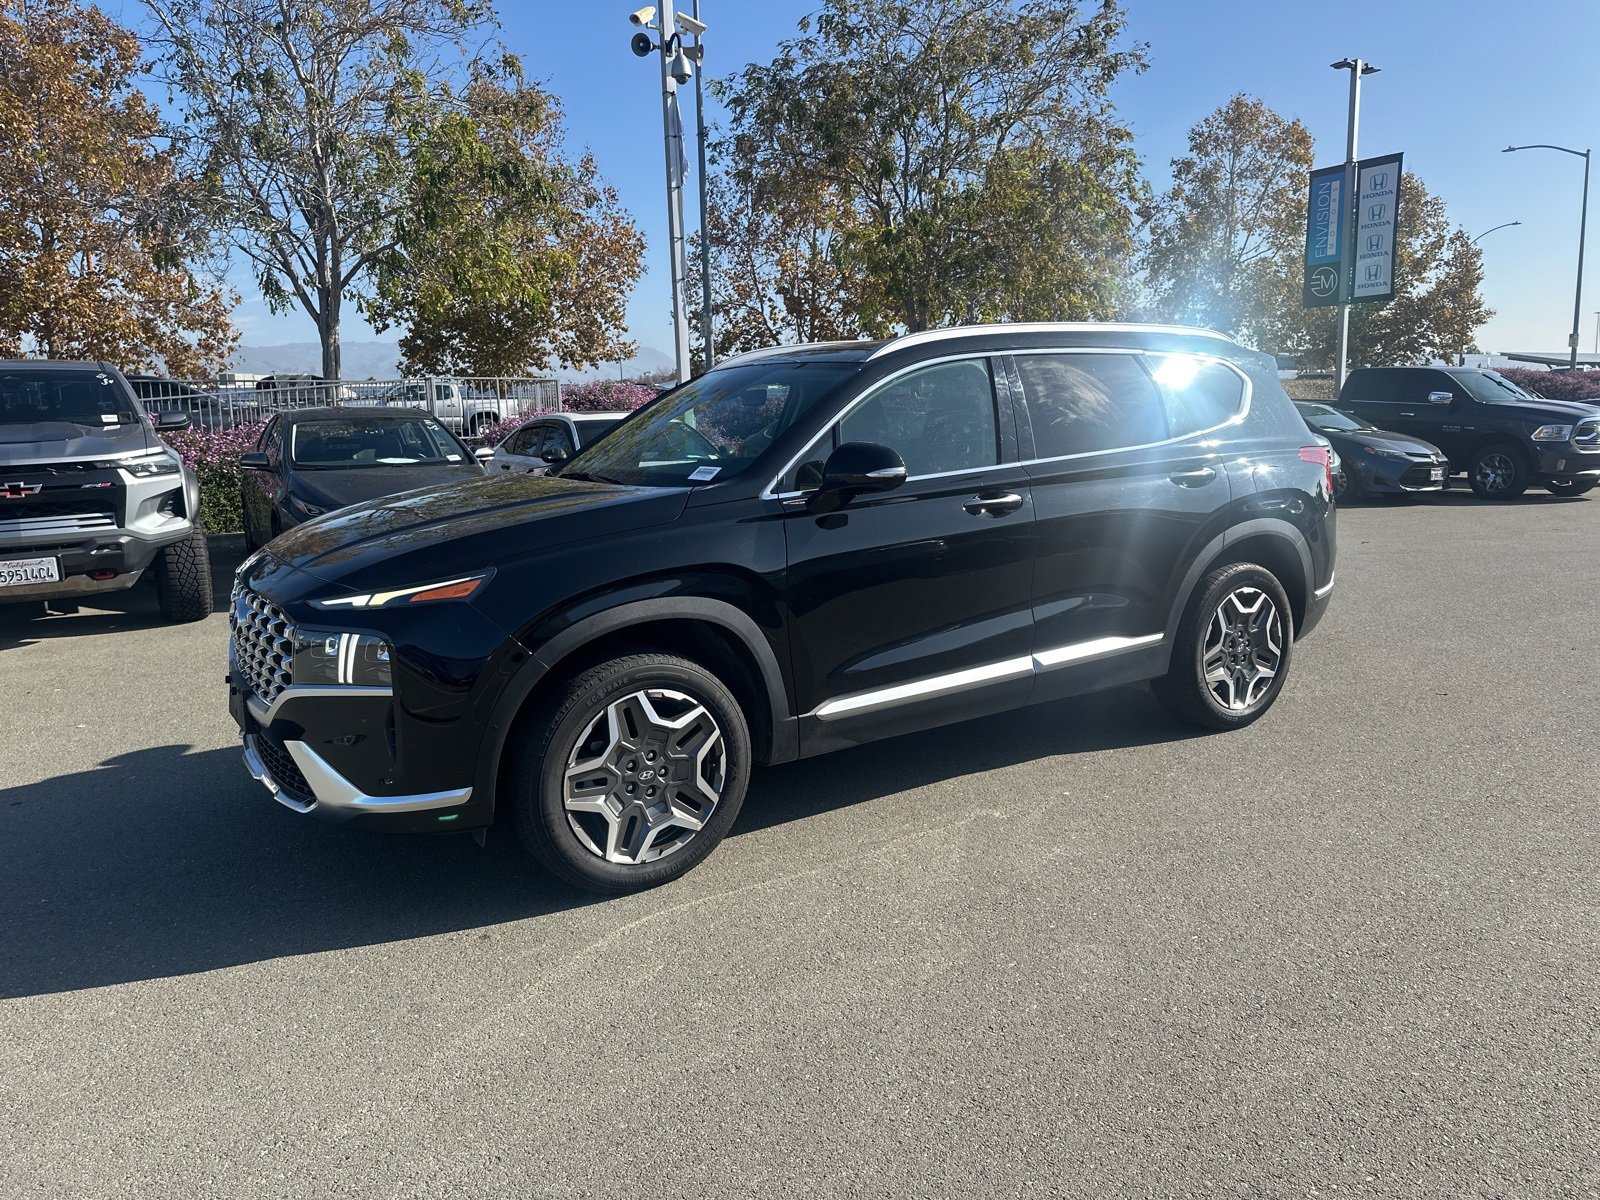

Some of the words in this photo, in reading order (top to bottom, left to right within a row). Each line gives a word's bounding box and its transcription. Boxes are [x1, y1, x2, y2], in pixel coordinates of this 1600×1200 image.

[1362, 189, 1393, 199] HONDA
[1315, 182, 1330, 257] ENVISION
[1328, 186, 1338, 250] MOTORS
[1360, 220, 1391, 230] HONDA
[1359, 251, 1390, 260] HONDA
[1357, 281, 1388, 289] HONDA
[0, 567, 54, 583] 59514C4
